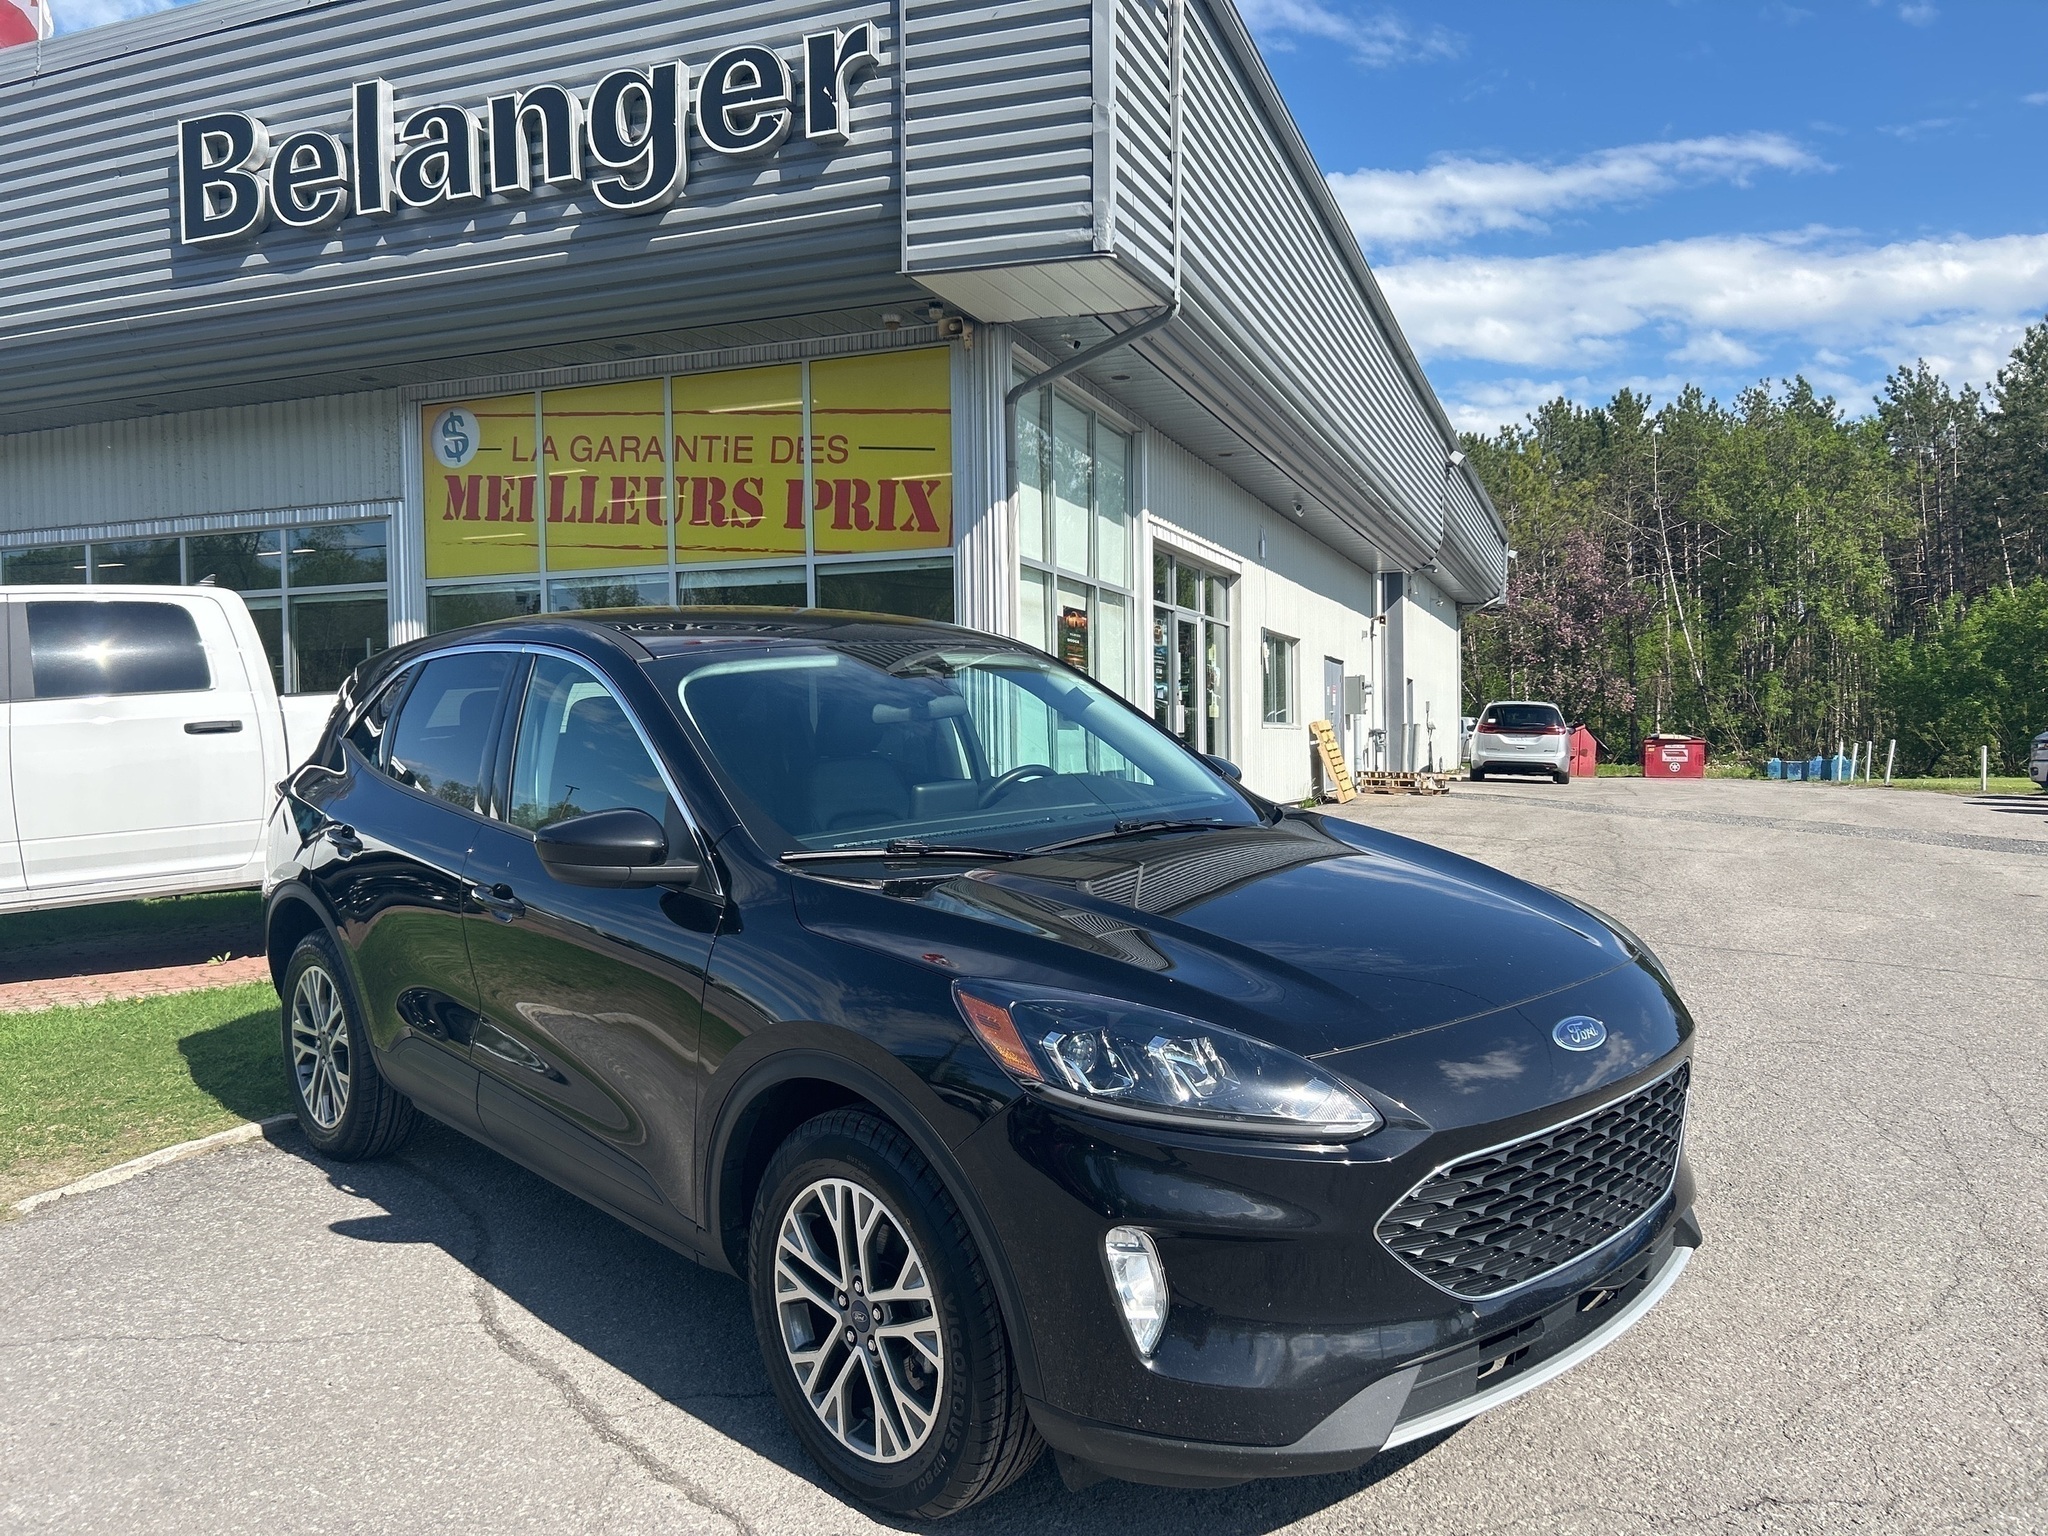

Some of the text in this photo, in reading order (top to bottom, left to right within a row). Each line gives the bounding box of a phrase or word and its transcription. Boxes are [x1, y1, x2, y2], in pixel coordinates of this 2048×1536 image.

[178, 21, 879, 246] Belanger
[512, 434, 849, 464] LA GARANTIE DES
[443, 475, 941, 533] MEILLEURS PRIX
[1566, 1021, 1599, 1043] Ford
[942, 1291, 968, 1453] VIGOROUS
[913, 1452, 947, 1496] HP801
